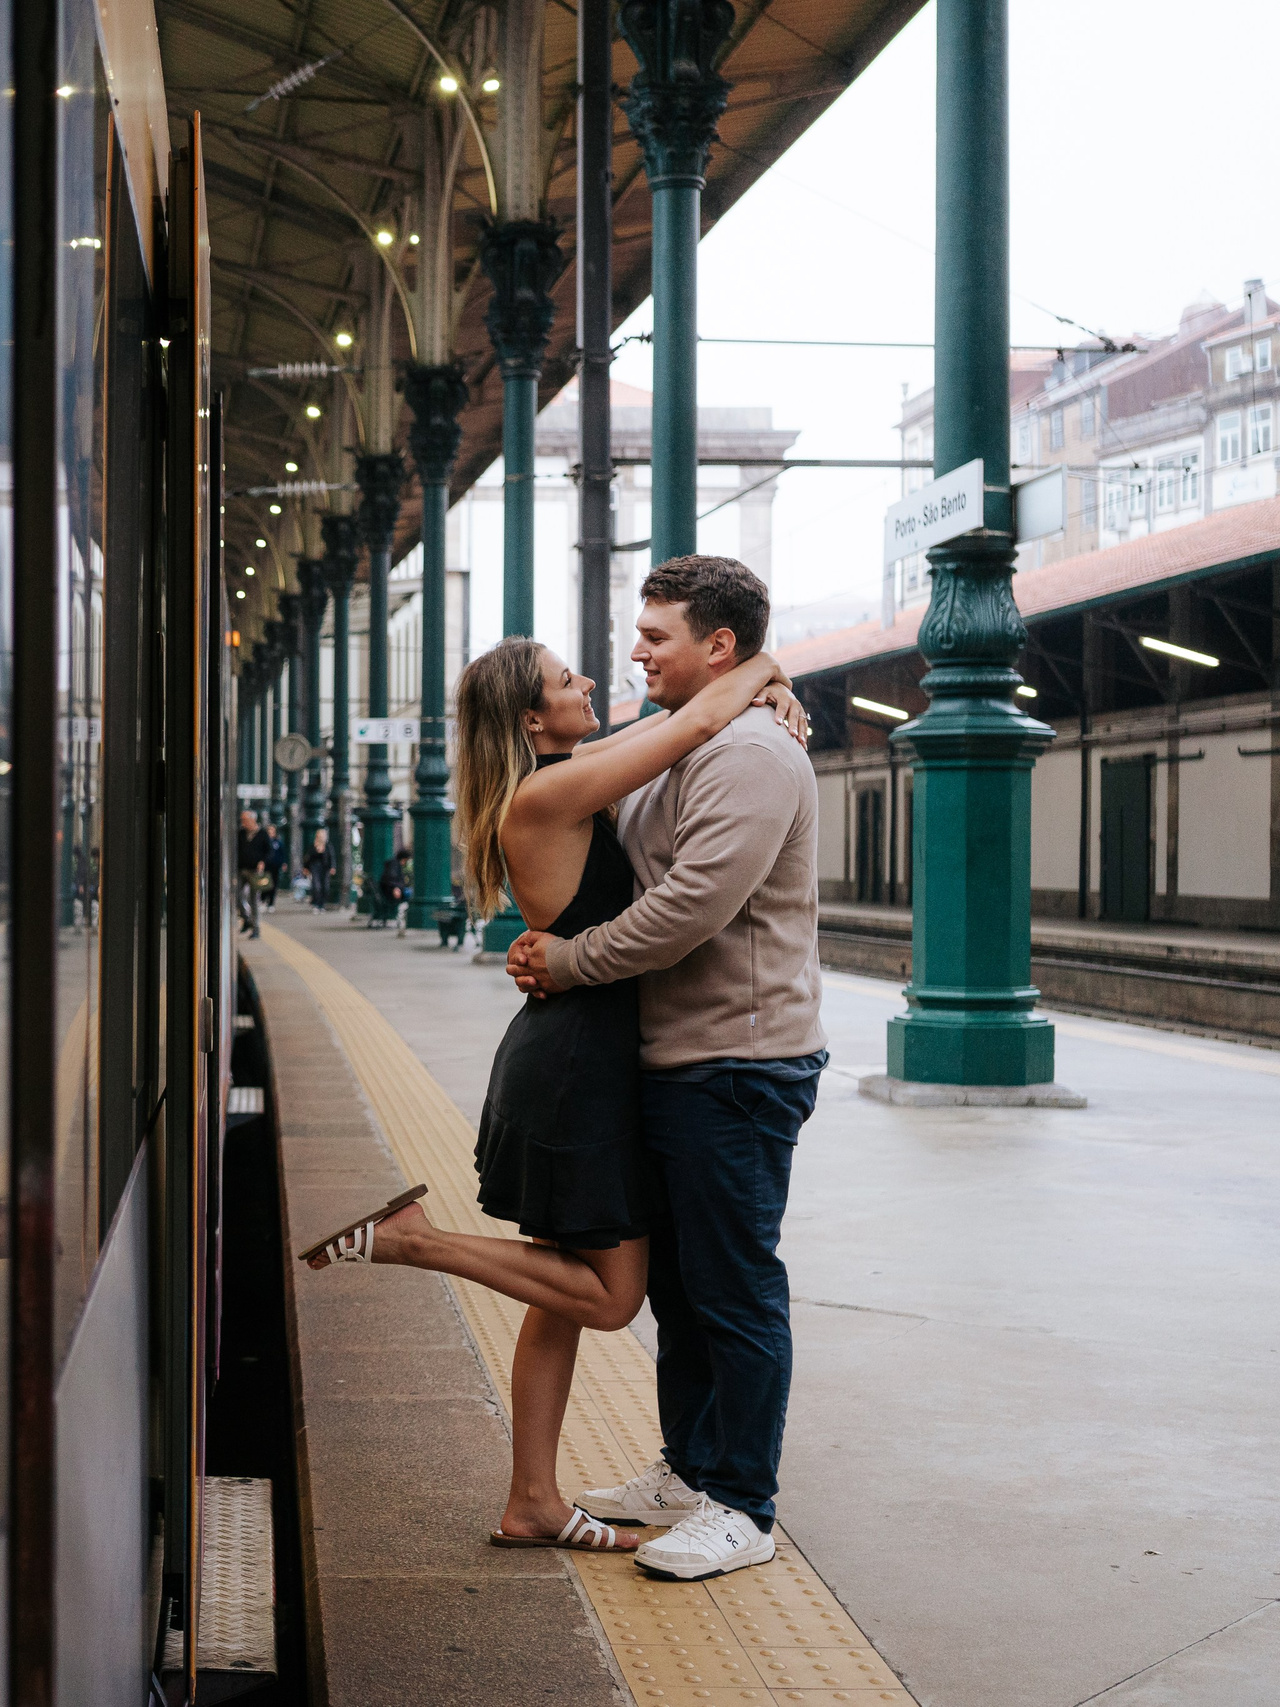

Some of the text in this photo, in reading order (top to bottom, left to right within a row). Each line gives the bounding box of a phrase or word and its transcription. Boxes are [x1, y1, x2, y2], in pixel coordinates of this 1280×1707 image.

[895, 515, 916, 540] Porto
[923, 502, 939, 527] São
[941, 491, 967, 518] Bento
